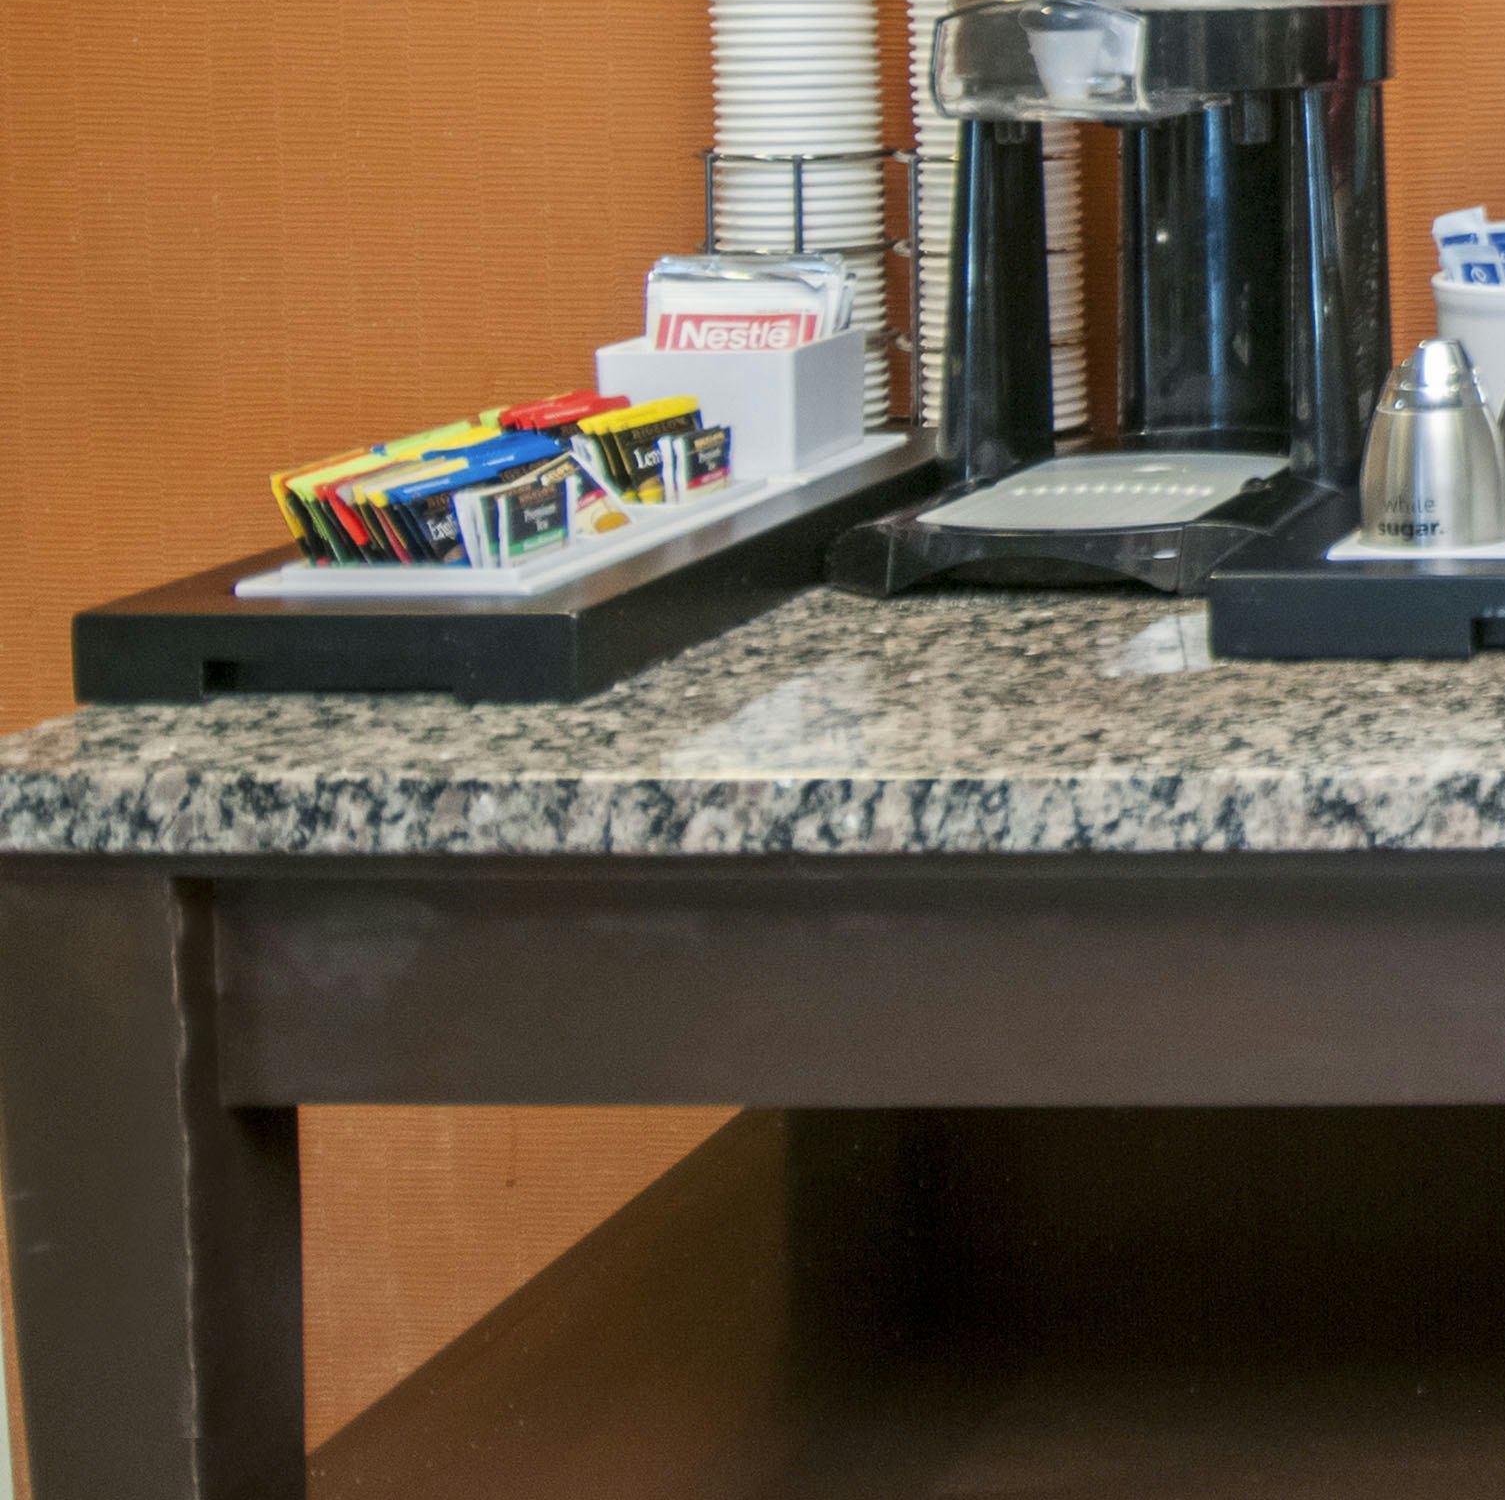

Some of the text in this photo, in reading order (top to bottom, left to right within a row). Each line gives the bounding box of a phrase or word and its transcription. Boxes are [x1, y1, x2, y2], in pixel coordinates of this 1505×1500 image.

[679, 317, 791, 350] Nestlé
[1382, 493, 1436, 514] white
[1378, 520, 1444, 542] sugar.
